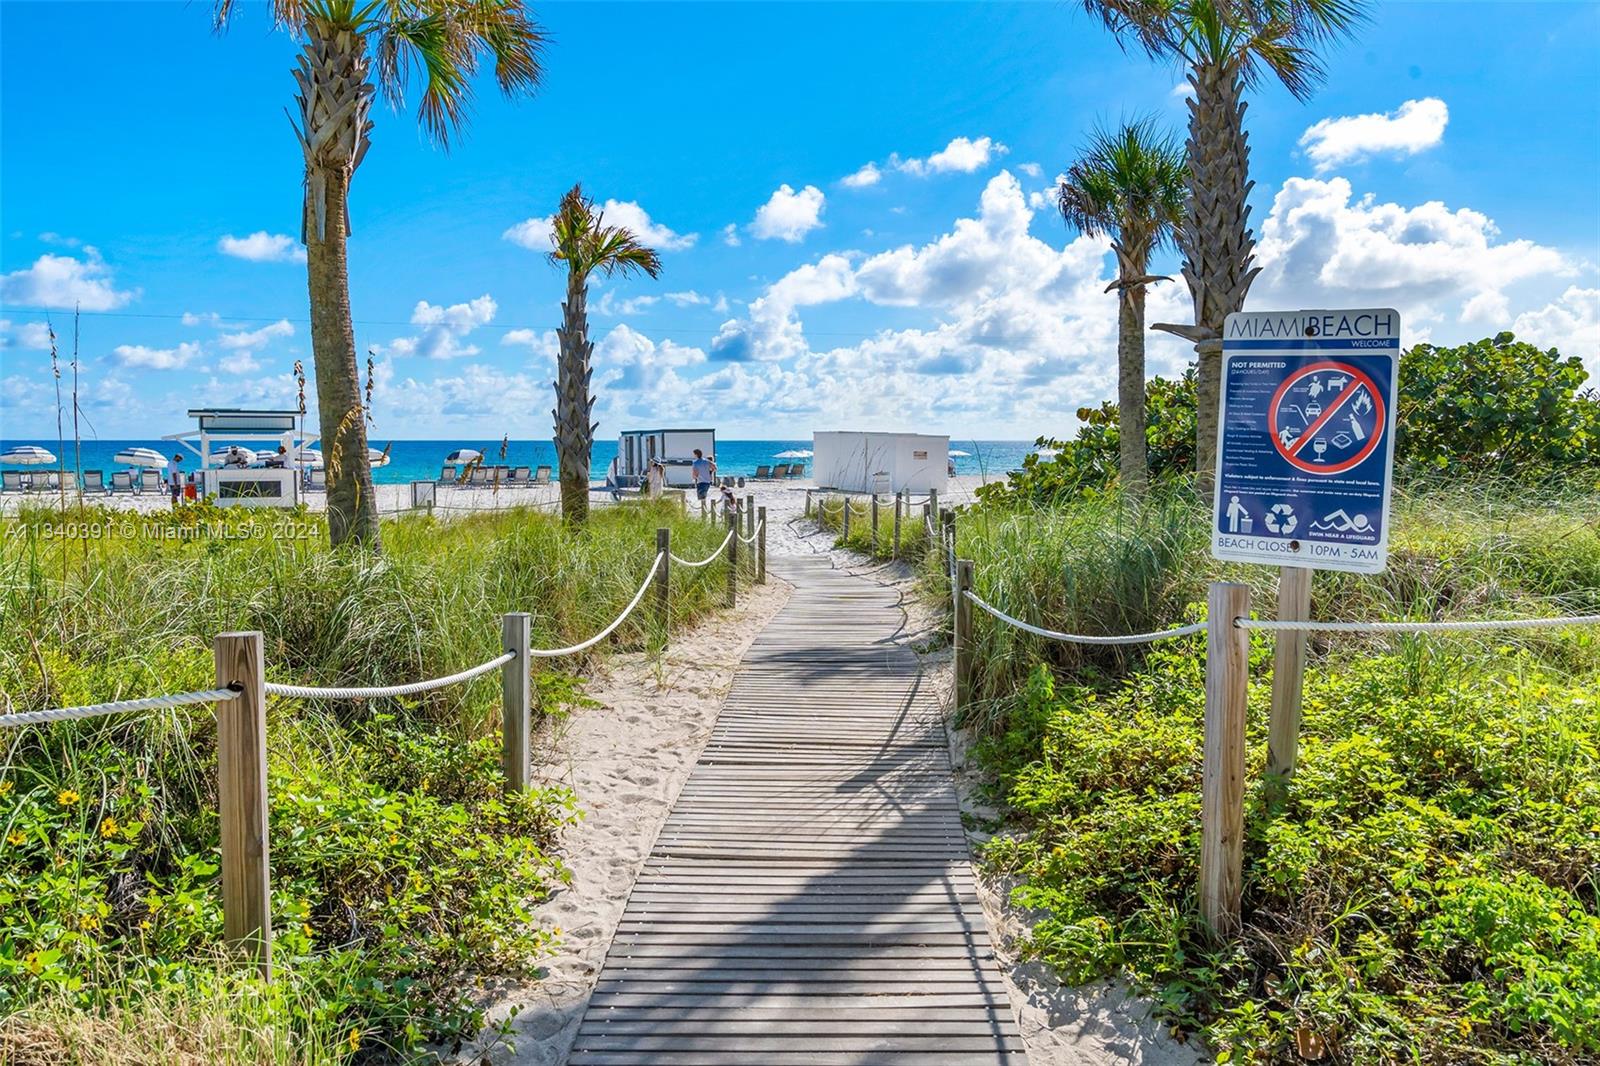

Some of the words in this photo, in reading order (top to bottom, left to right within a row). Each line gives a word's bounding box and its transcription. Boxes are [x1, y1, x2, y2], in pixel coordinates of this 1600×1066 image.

[1351, 339, 1391, 348] WELCOME
[1231, 361, 1247, 369] NOT
[1248, 361, 1287, 369] PERMITTED
[1218, 537, 1254, 549] BEACH
[1310, 544, 1341, 557] 10PM
[1350, 548, 1379, 560] 5AM
